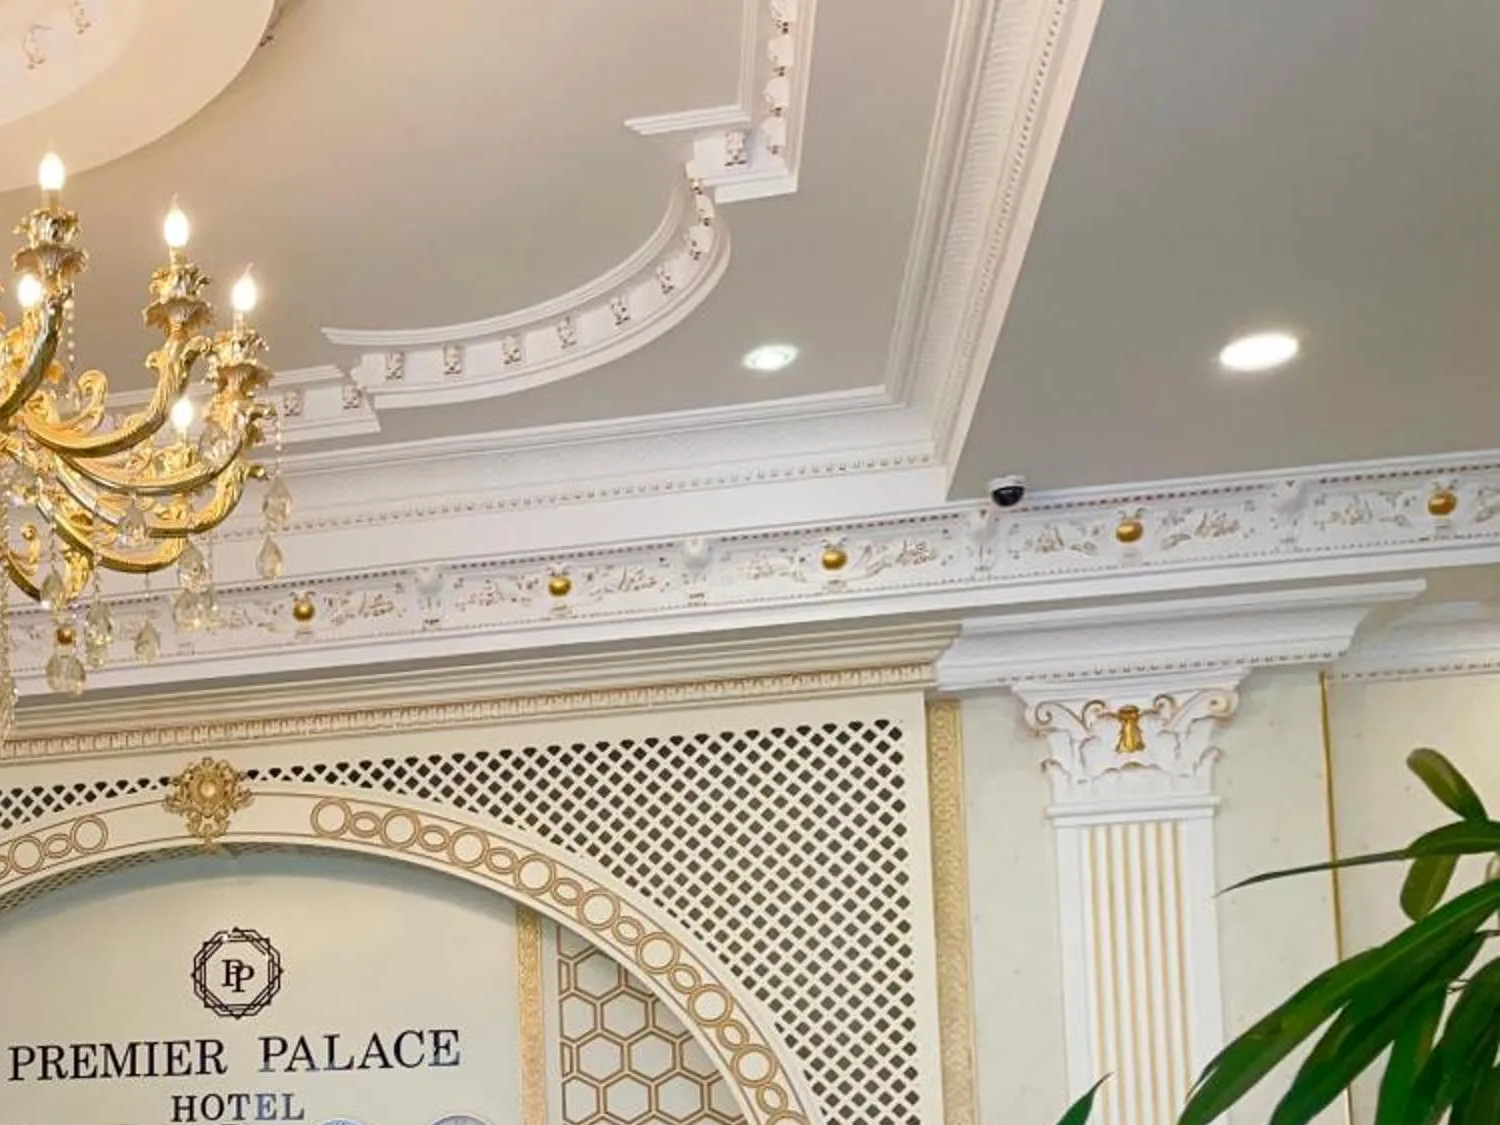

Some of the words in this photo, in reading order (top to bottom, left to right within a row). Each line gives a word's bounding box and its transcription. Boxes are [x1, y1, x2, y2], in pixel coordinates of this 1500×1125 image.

[7, 1038, 228, 1081] PREMIER
[258, 1029, 461, 1073] PALACE
[171, 1093, 305, 1123] HOTEL
